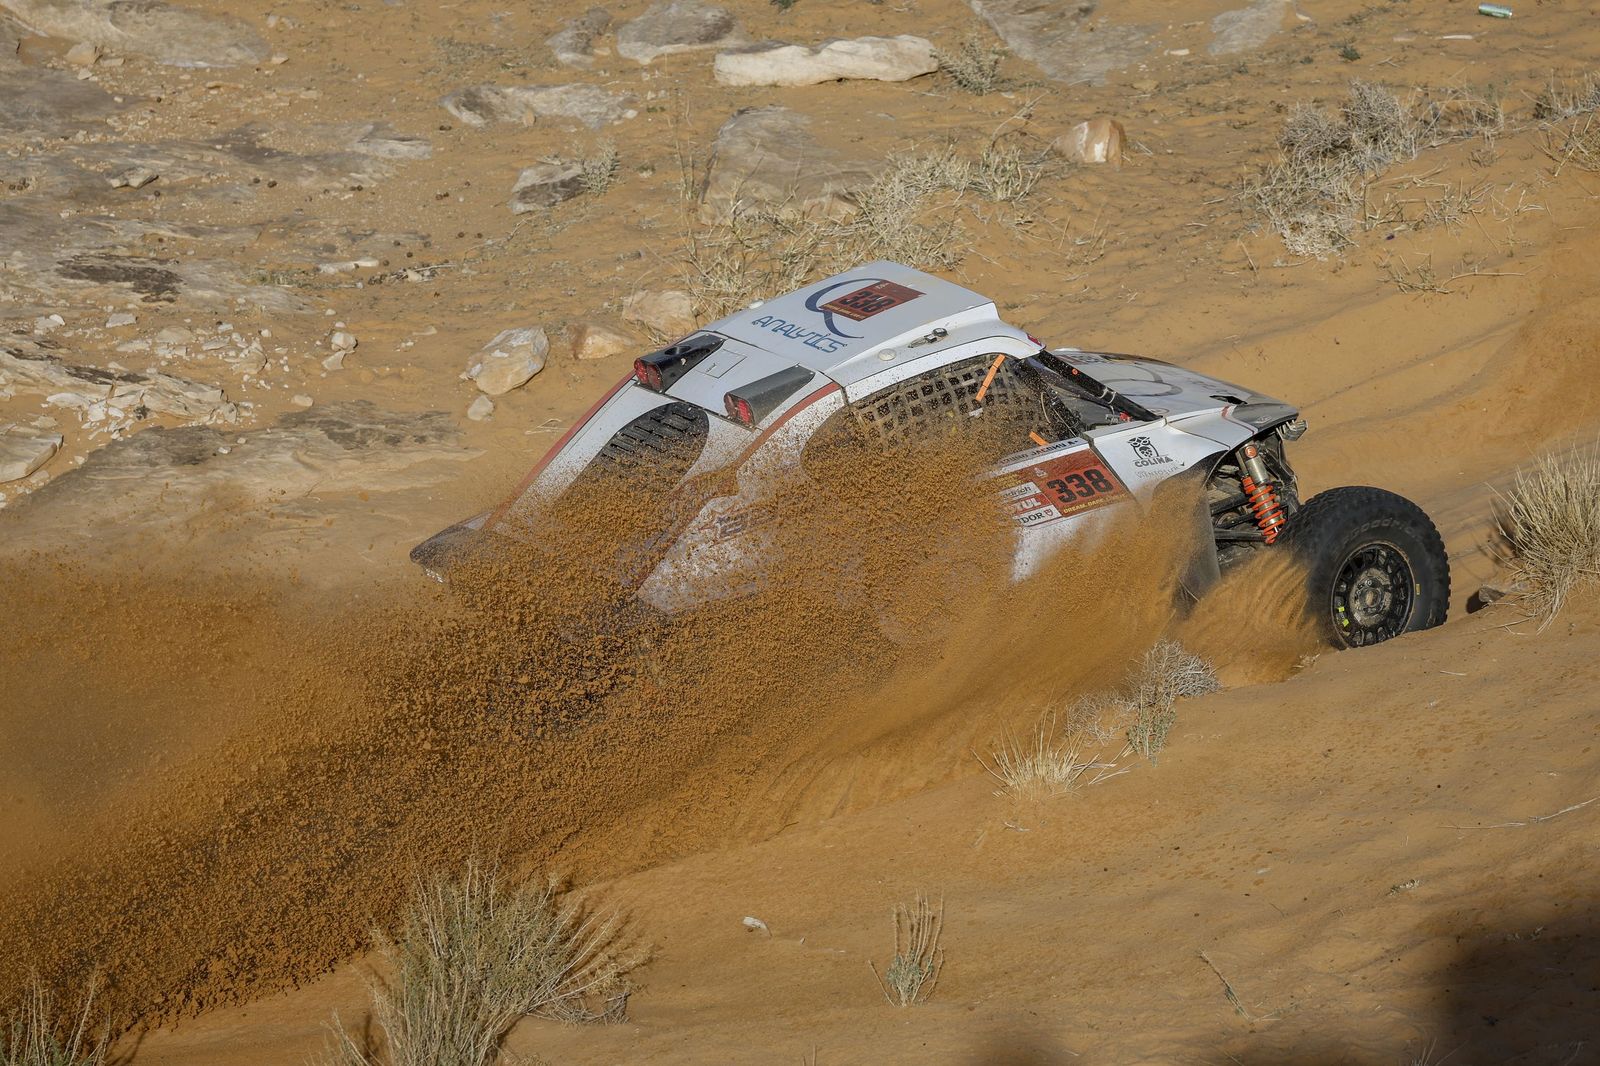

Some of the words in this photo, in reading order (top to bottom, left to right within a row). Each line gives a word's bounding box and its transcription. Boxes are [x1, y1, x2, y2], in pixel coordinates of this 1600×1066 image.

[751, 317, 847, 353] ANALYTICS
[1135, 456, 1173, 467] COLINA
[1046, 468, 1115, 503] 338
